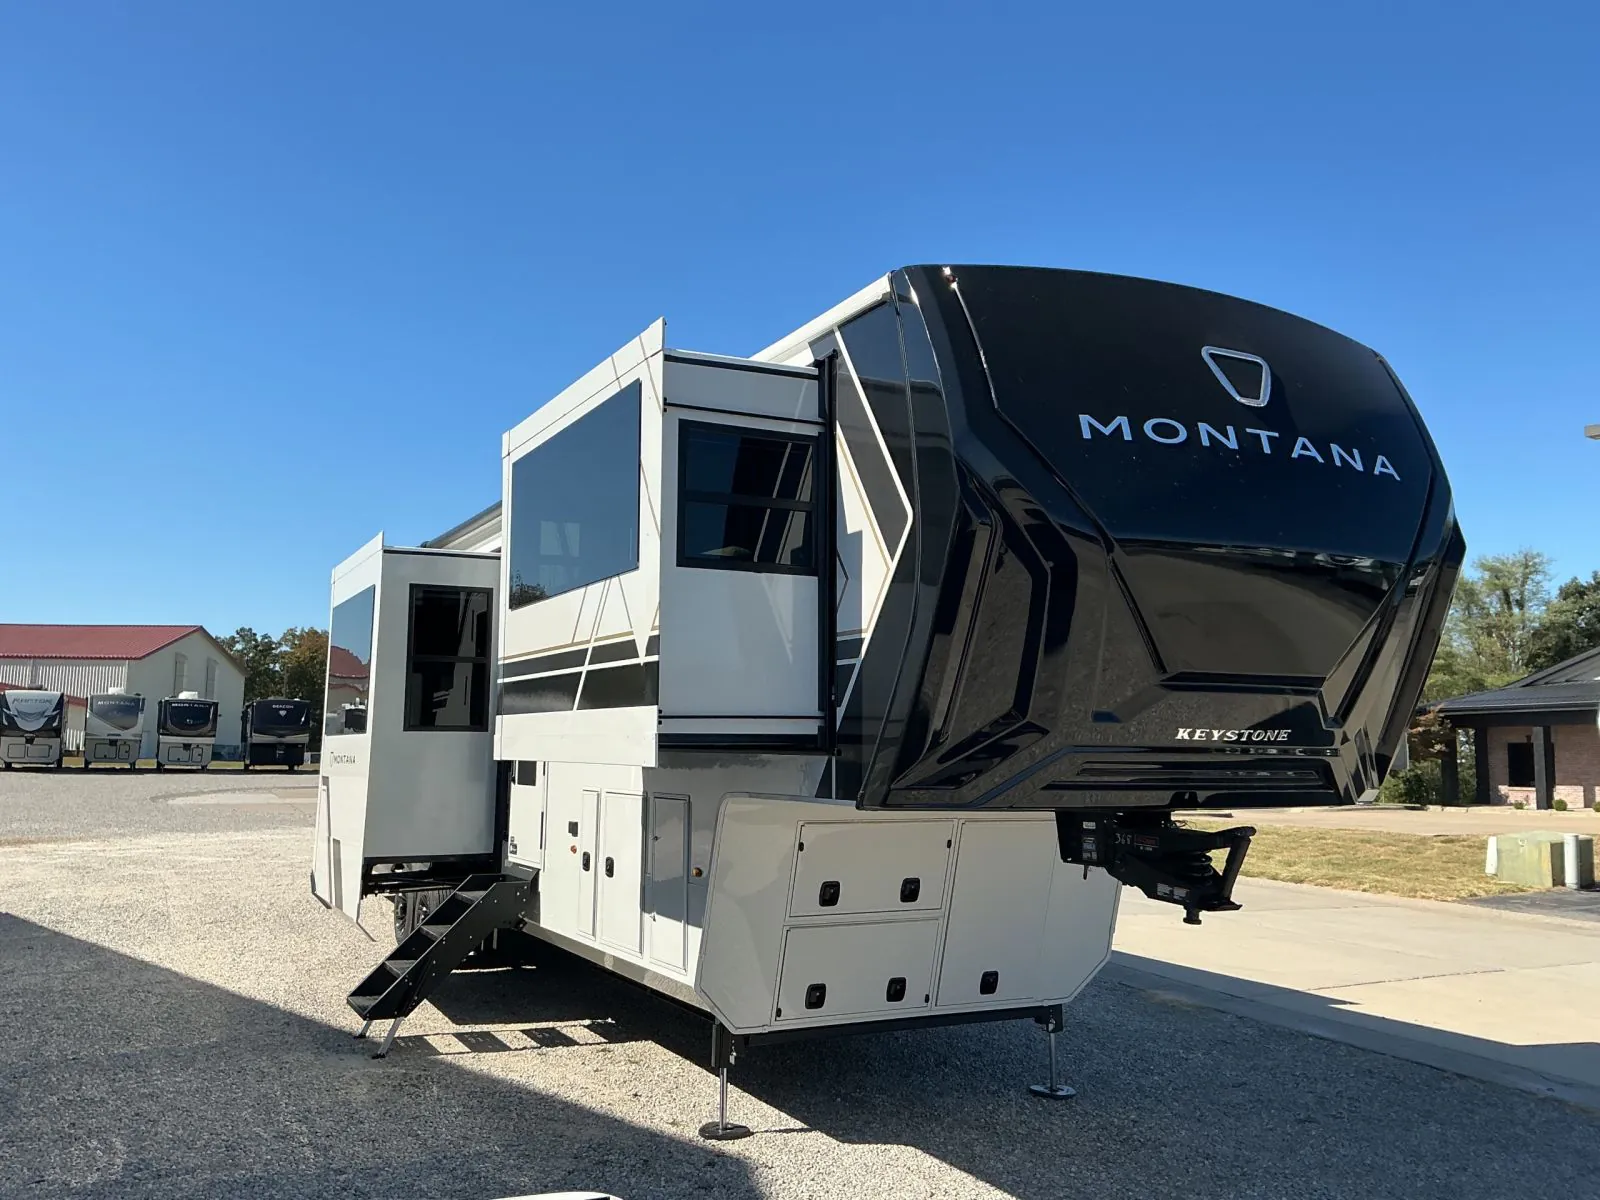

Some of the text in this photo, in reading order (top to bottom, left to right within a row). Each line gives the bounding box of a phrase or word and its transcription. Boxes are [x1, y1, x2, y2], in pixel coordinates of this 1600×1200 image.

[1078, 414, 1401, 481] MONTANA
[1175, 727, 1291, 741] KEYSTONE
[333, 754, 356, 765] MONTANA
